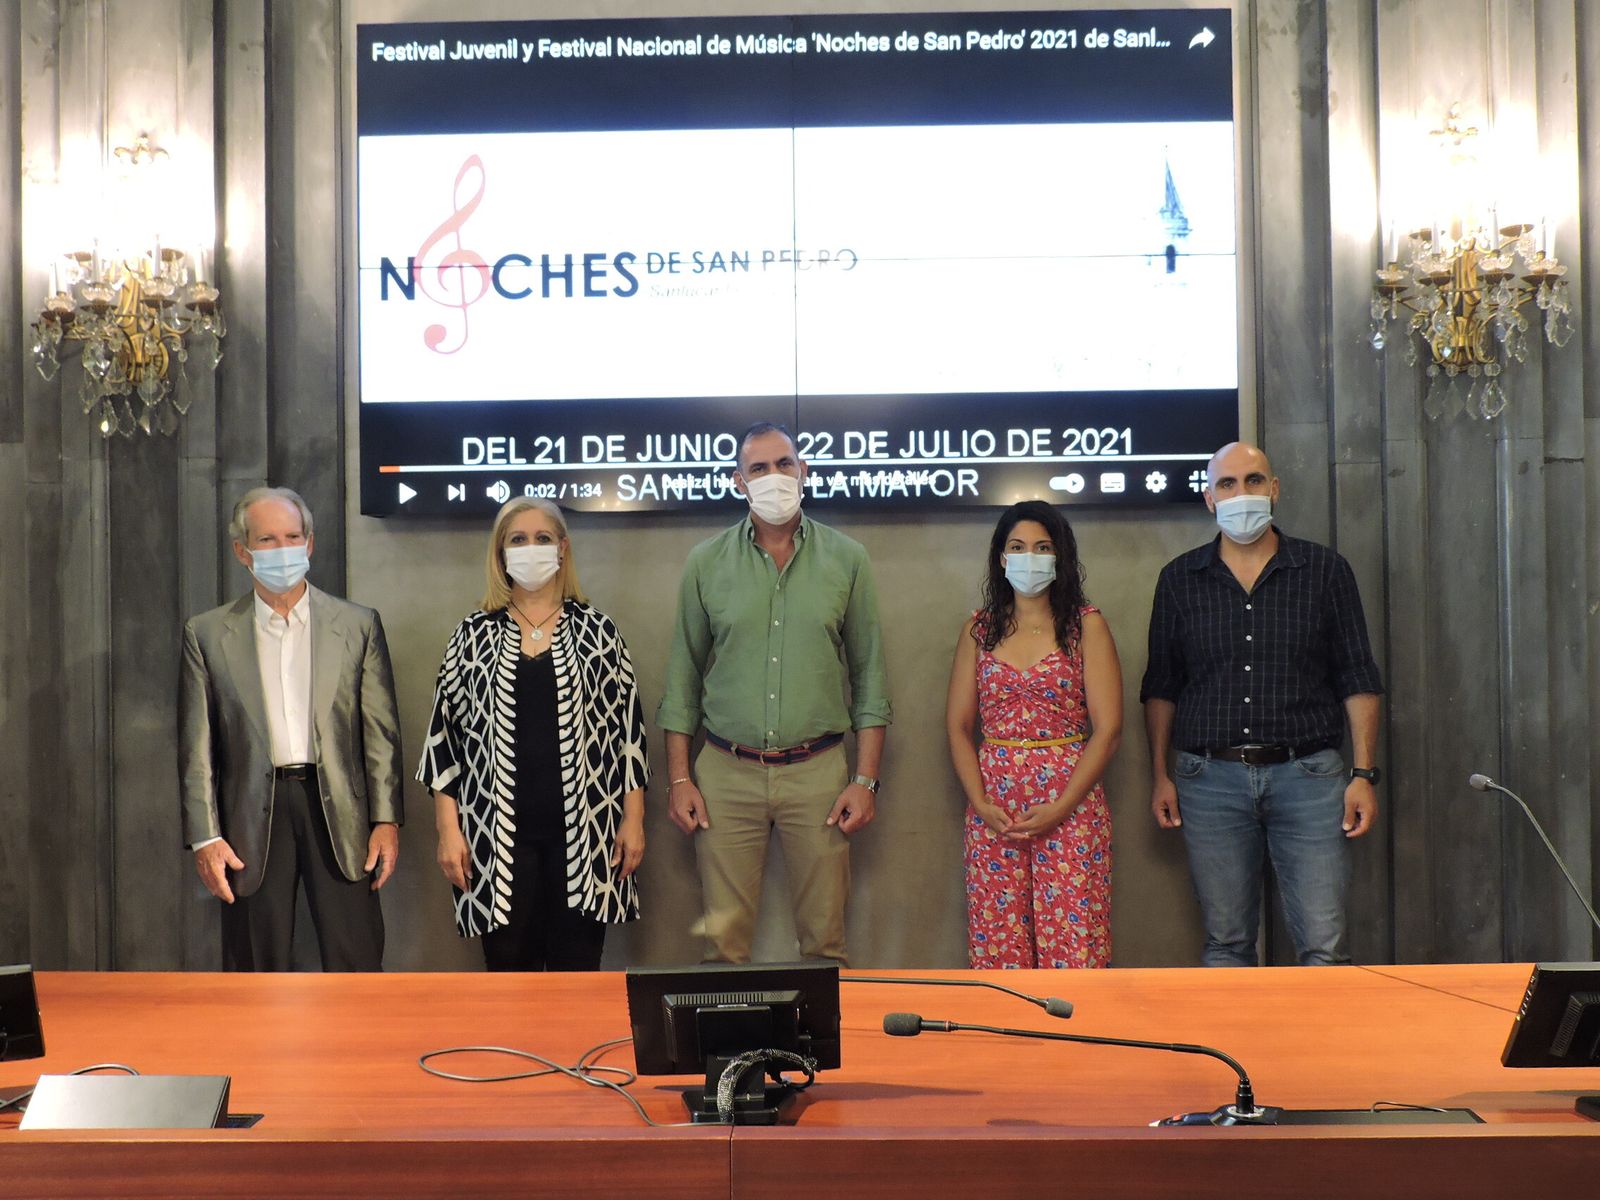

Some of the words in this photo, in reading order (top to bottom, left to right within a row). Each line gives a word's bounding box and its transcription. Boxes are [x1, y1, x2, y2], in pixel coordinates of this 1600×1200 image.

[372, 41, 445, 61] Festival
[450, 38, 518, 60] Juvenil
[521, 41, 534, 63] y
[538, 37, 612, 59] Festival
[617, 35, 702, 57] Nacional
[706, 34, 731, 55] de
[736, 33, 807, 54] Música
[811, 30, 890, 52] 'Noches
[895, 30, 919, 51] de
[924, 30, 961, 51] San
[966, 29, 1026, 50] Pedro'
[1030, 29, 1078, 49] 2021
[1084, 28, 1109, 48] de
[647, 251, 681, 274] DE
[692, 250, 750, 274] SAN
[462, 436, 526, 465] DEL
[533, 435, 566, 464] 21
[581, 434, 627, 463] DE
[636, 433, 737, 462] JUNIO
[797, 431, 834, 460] 22
[844, 430, 889, 459] DE
[899, 429, 996, 458] JULIO
[1007, 428, 1052, 457] DE
[1062, 427, 1133, 455] 2021
[524, 483, 557, 499] 0:02
[570, 482, 602, 498] 1:34
[617, 466, 804, 501] SANLÚC
[811, 471, 851, 499] LA
[859, 469, 979, 498] MAYOR
